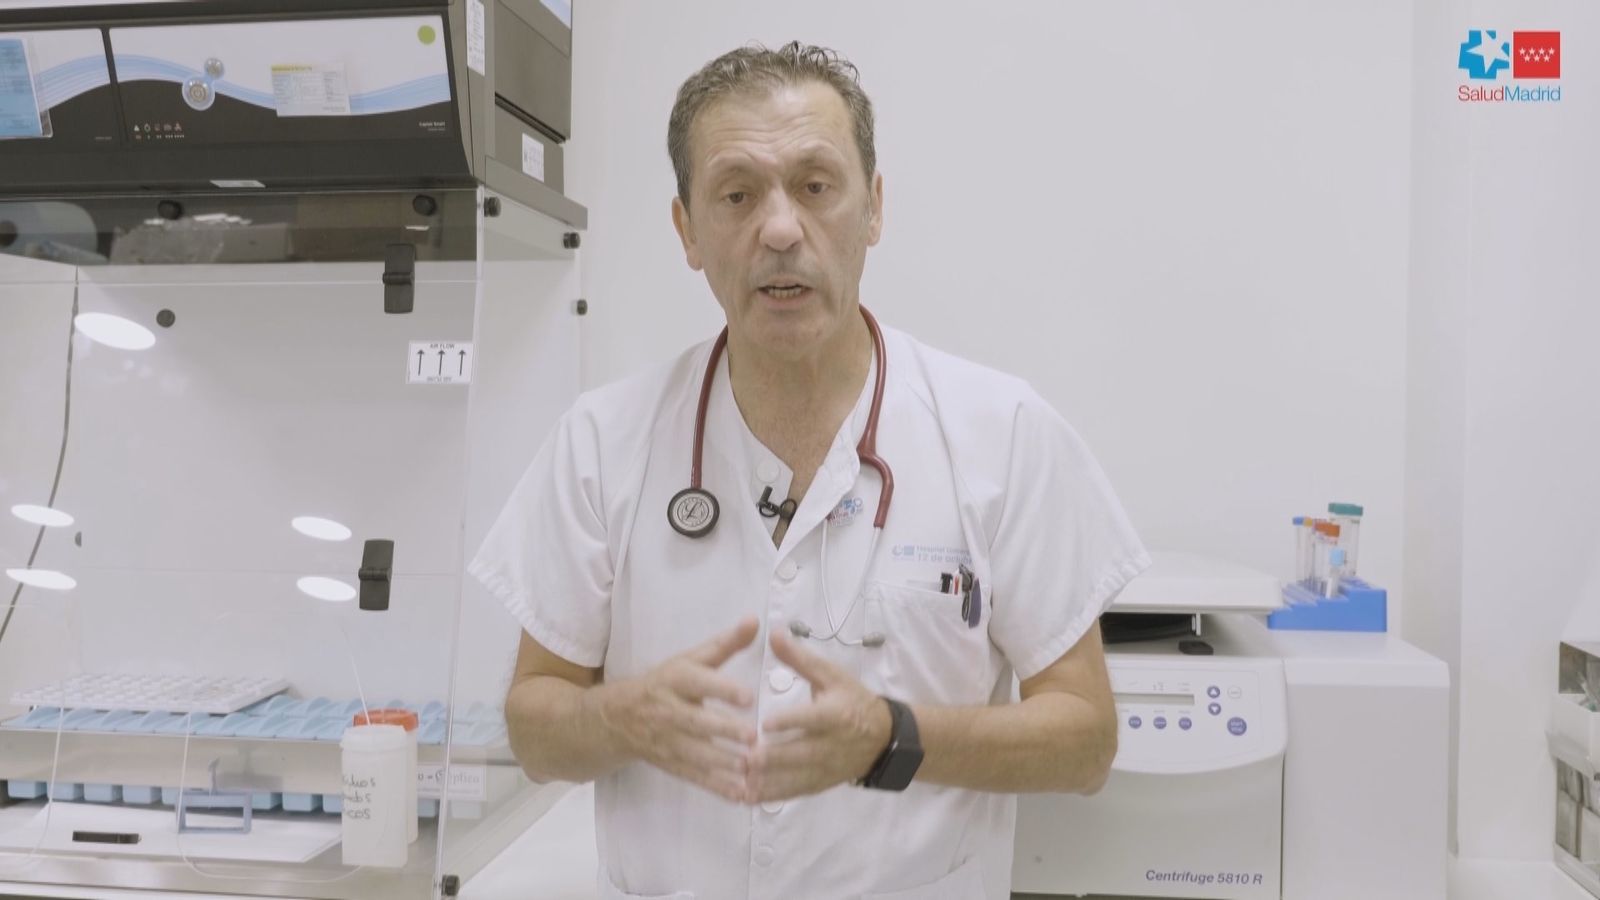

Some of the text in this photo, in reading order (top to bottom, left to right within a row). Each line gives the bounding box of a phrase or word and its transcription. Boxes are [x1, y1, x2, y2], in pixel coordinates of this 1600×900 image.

[1145, 869, 1263, 885] Centrifuge 5810 R
